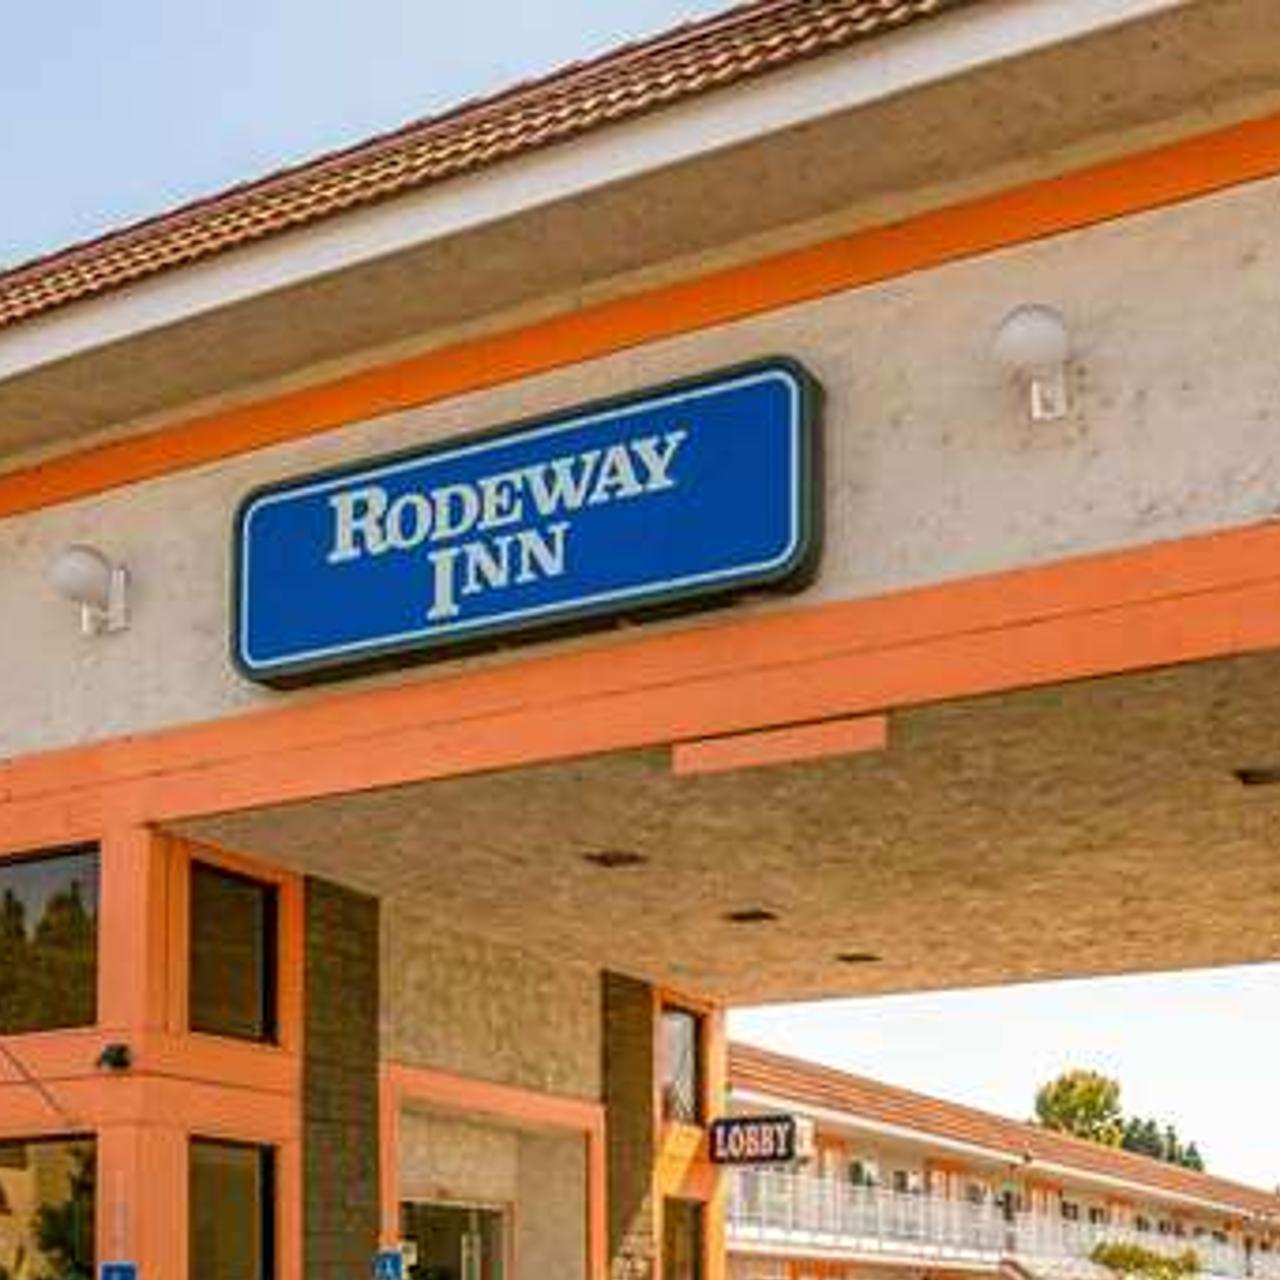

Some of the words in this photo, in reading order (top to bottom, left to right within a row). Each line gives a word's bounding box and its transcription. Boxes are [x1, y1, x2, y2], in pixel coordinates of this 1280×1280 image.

[326, 431, 688, 564] RODEWAY
[426, 522, 570, 619] INN
[715, 1122, 790, 1158] LOBBY
